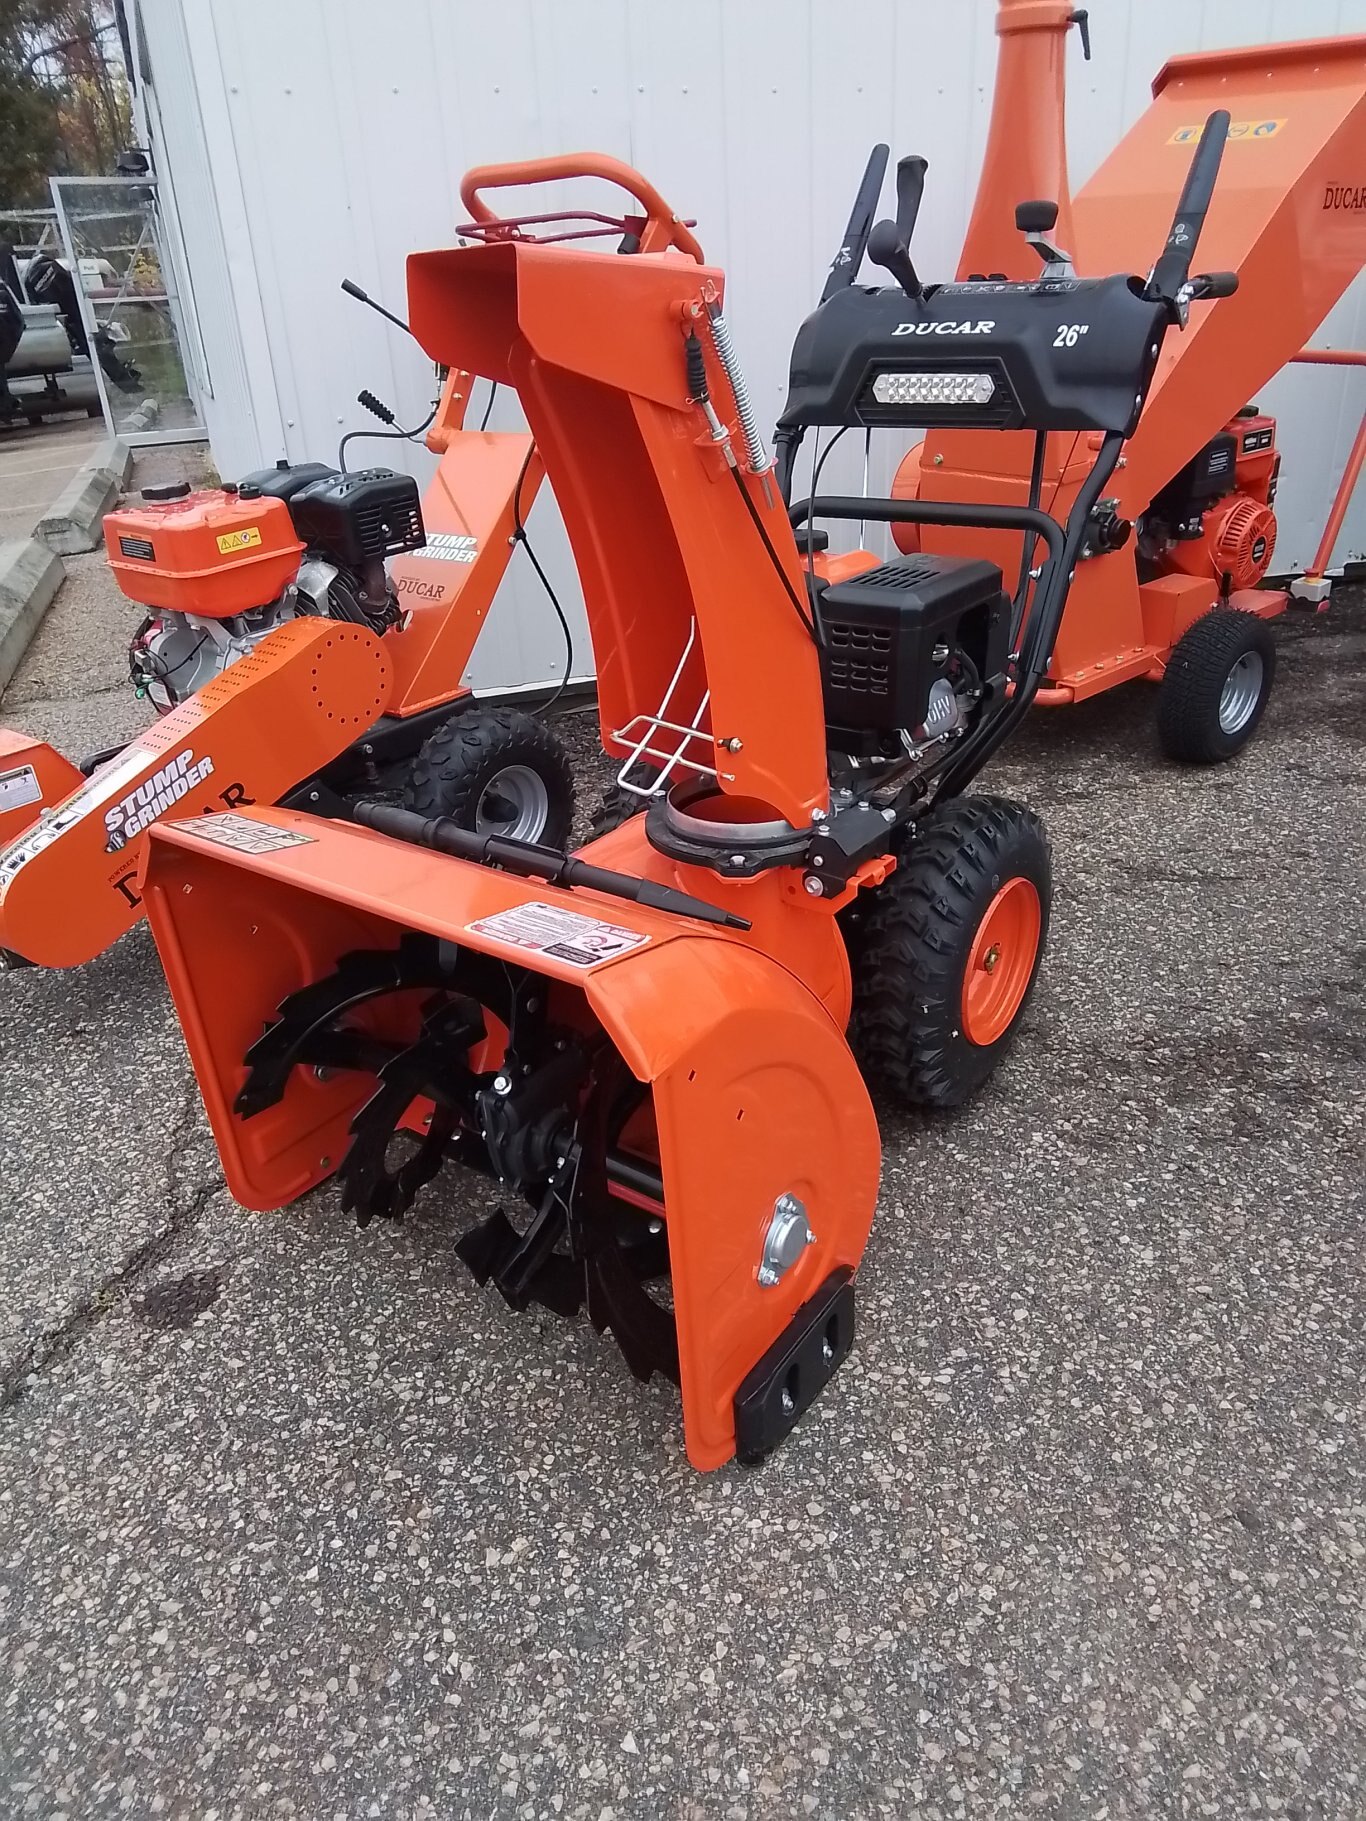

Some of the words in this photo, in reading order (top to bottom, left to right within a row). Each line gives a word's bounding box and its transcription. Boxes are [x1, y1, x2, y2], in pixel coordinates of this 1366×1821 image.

[891, 321, 996, 336] DUCAR
[1052, 324, 1089, 347] 26"
[398, 579, 445, 599] DUCAR
[927, 695, 951, 723] OHV
[104, 749, 194, 832] STUMP
[124, 756, 215, 839] GRINDER
